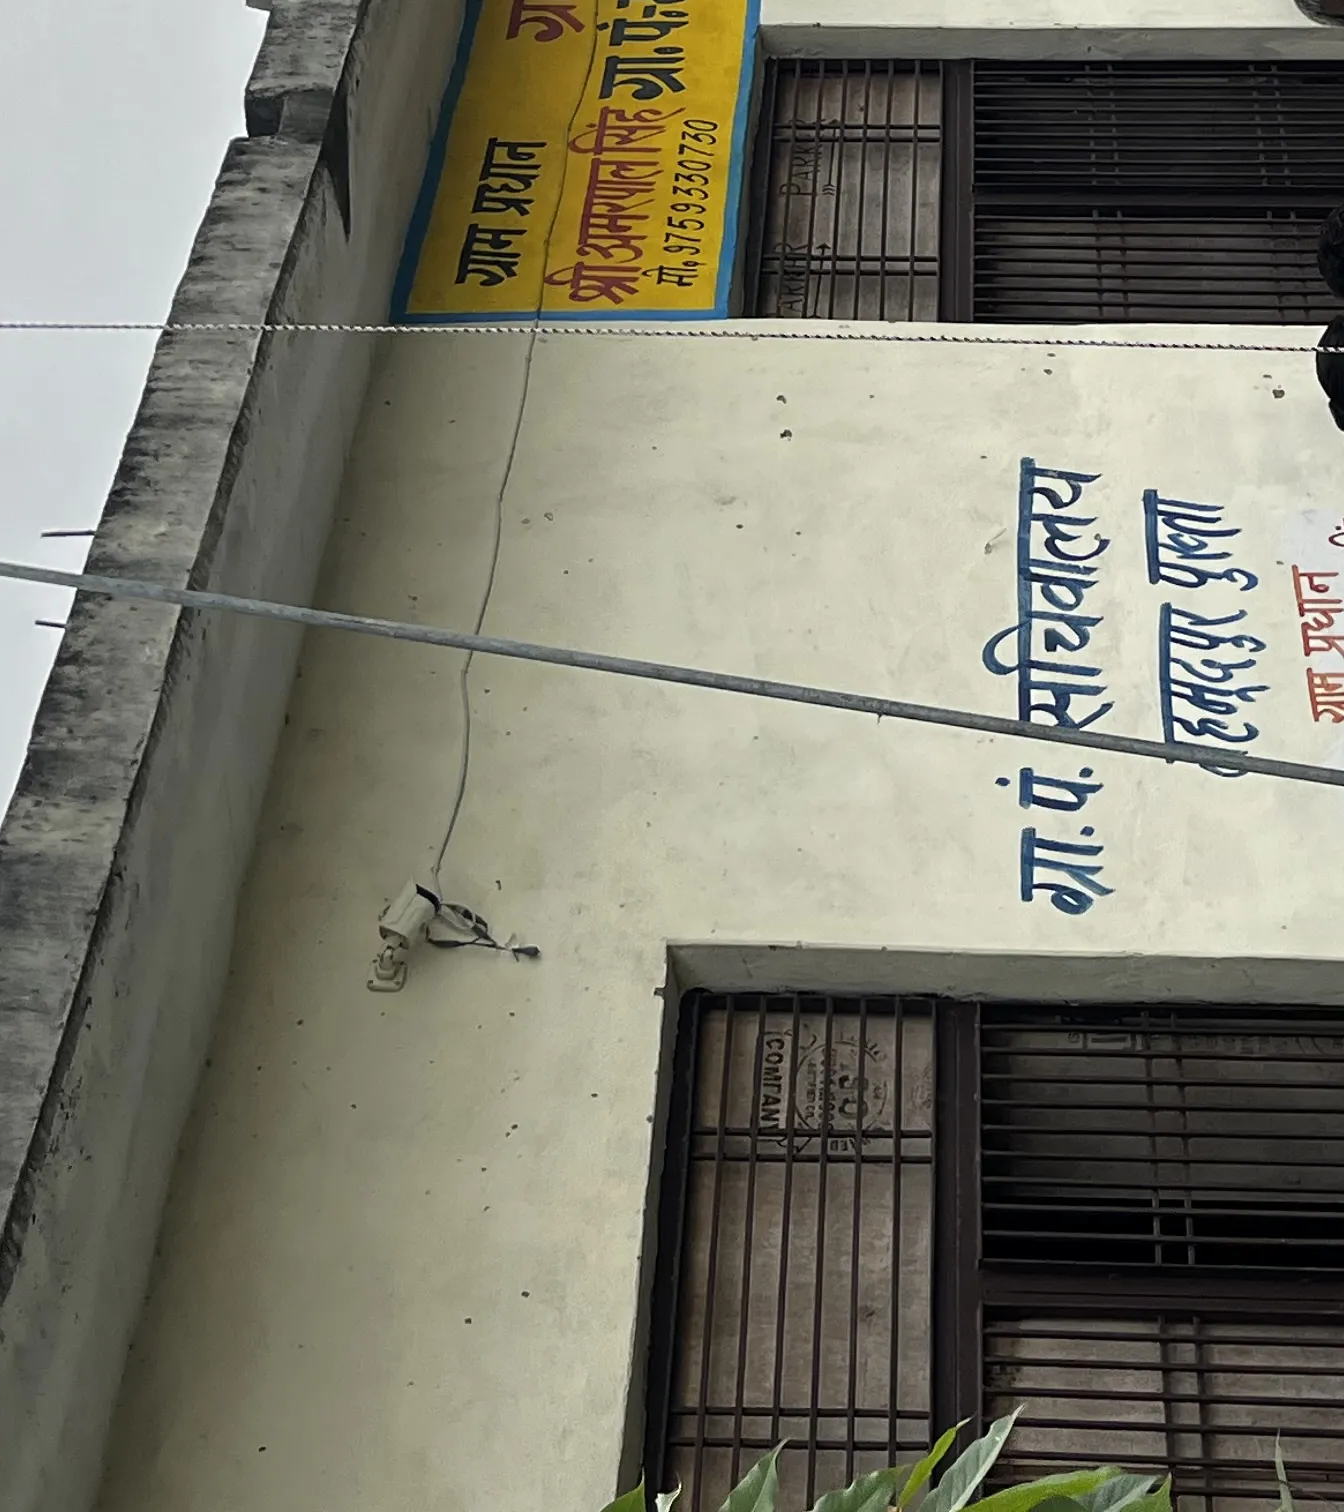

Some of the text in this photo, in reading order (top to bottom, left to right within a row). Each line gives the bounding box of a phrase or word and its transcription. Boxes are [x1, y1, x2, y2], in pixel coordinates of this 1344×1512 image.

[454, 138, 546, 287] ग्राम प्रधान
[543, 106, 686, 305] श्री अमरपाल सिंह
[662, 118, 718, 256] 9759330730
[982, 457, 1115, 733] सचिवालय
[994, 766, 1104, 813] पं.
